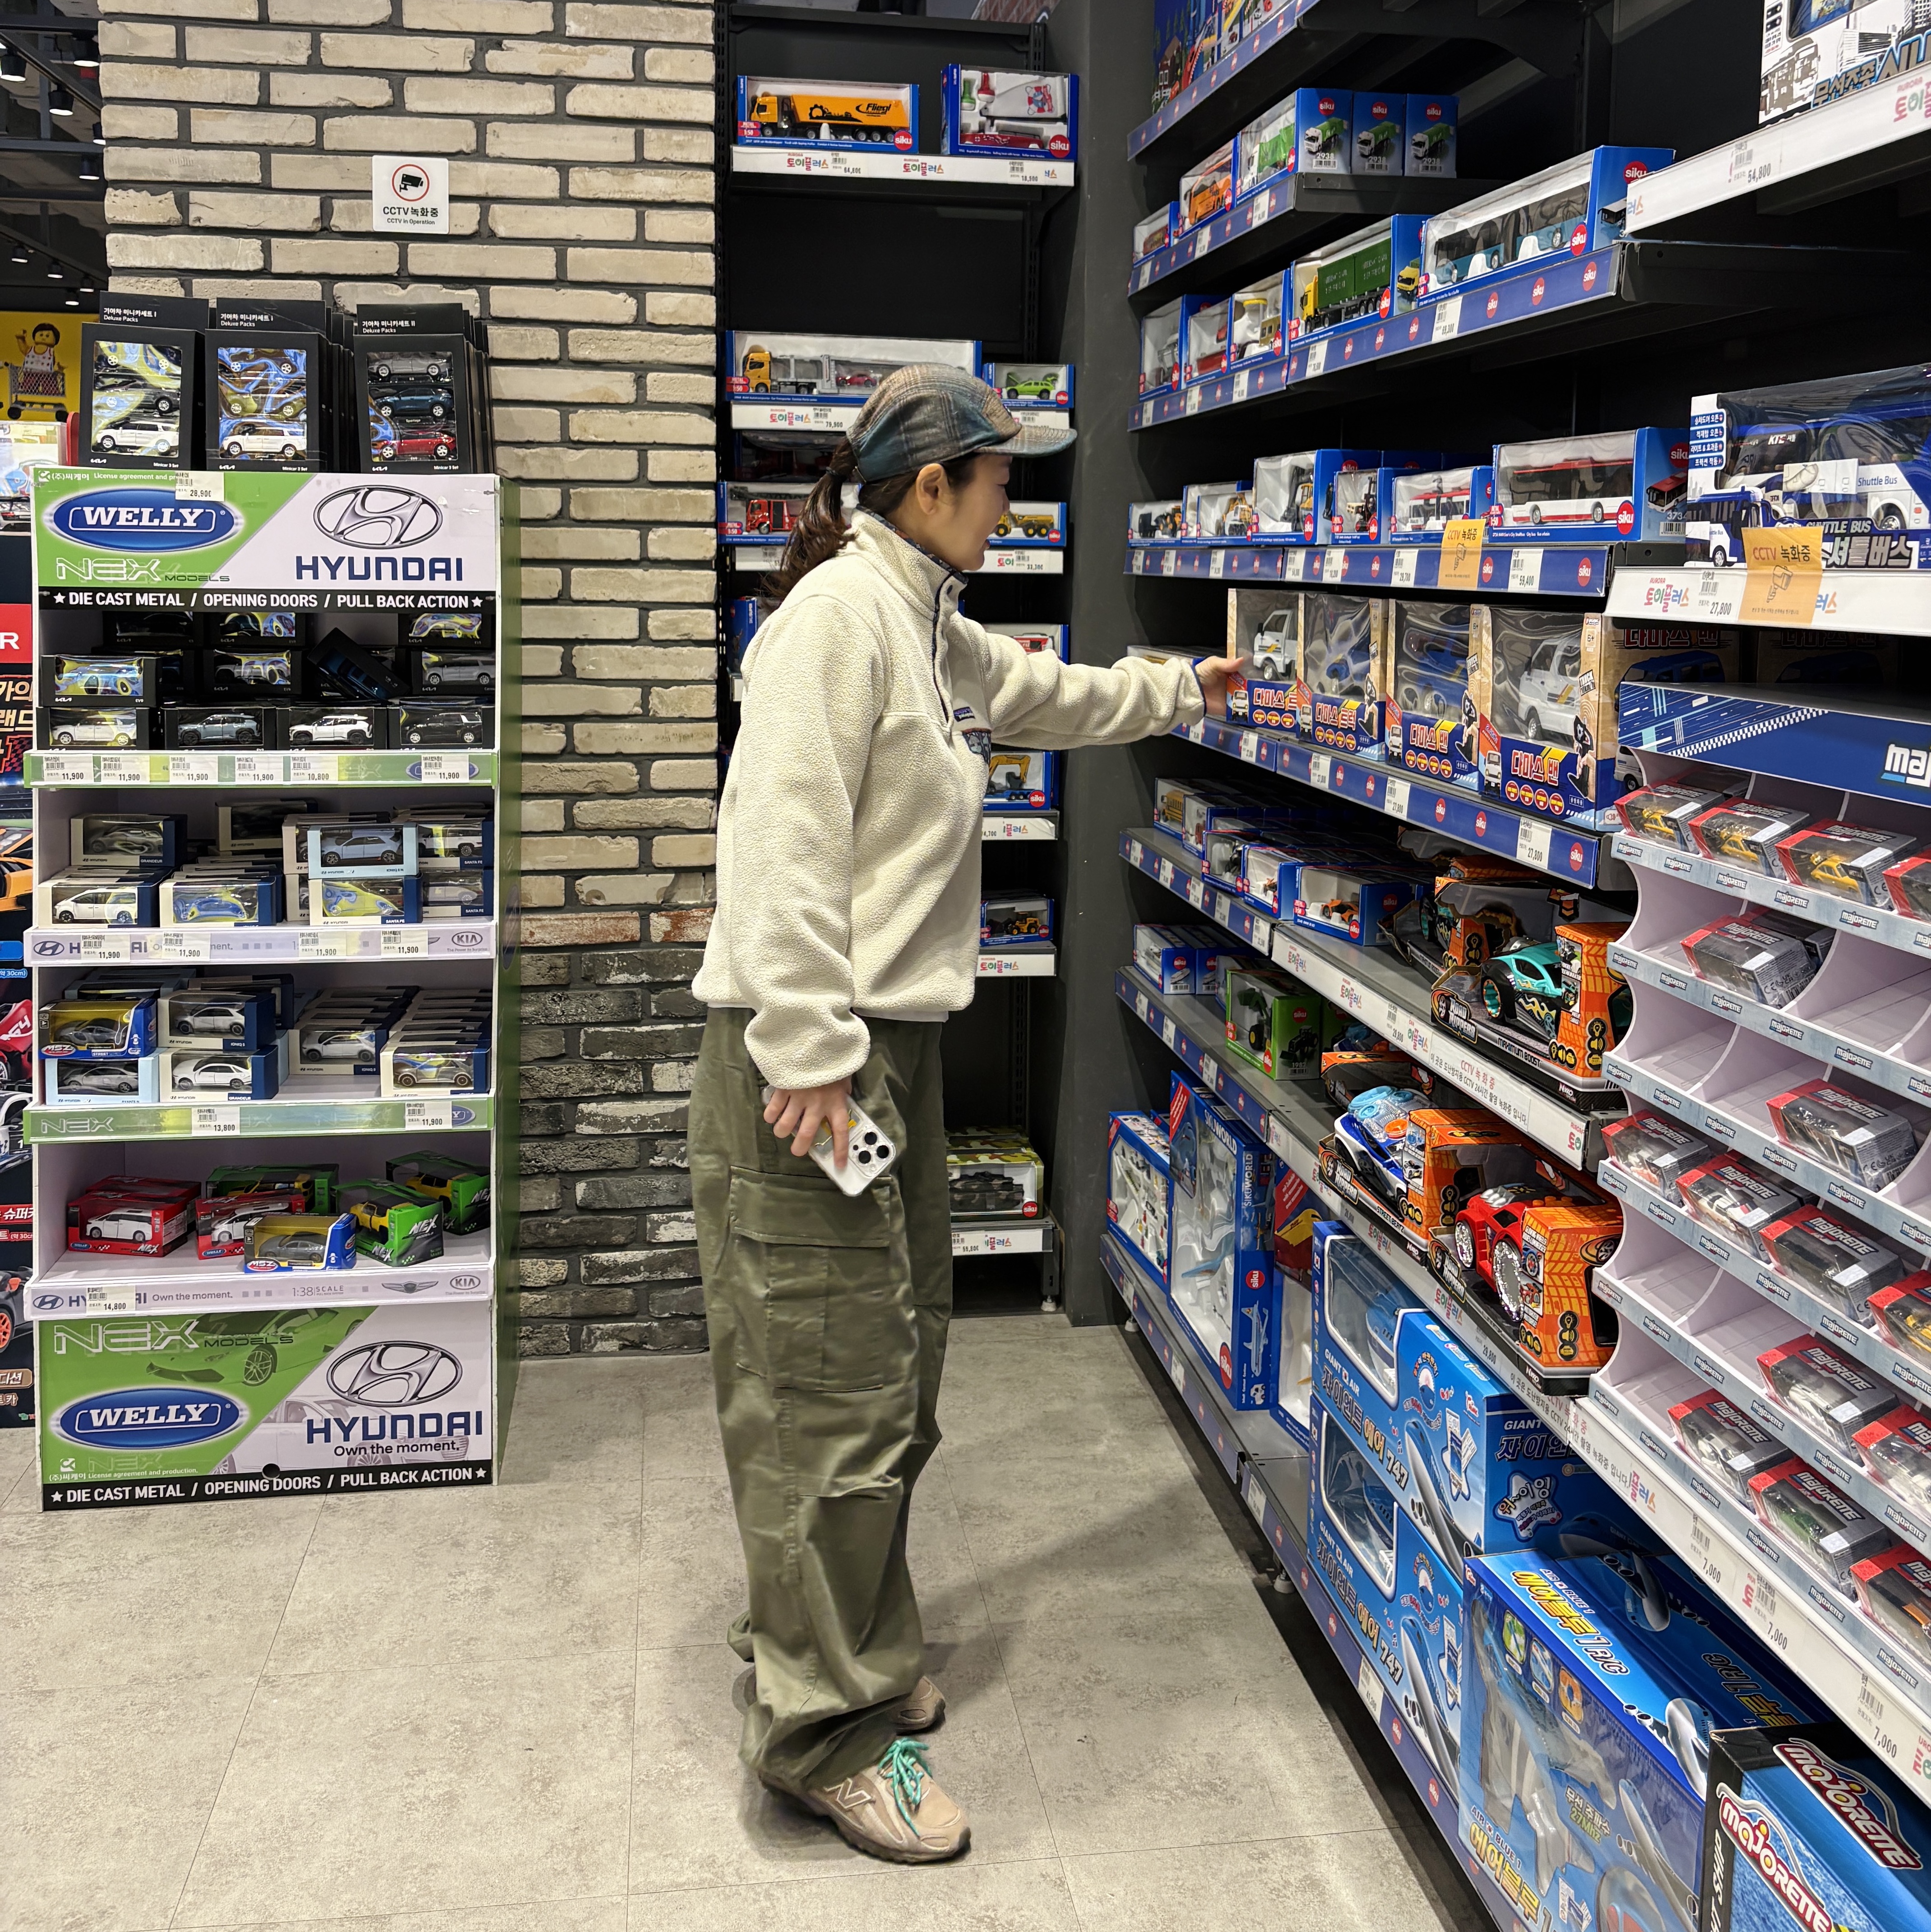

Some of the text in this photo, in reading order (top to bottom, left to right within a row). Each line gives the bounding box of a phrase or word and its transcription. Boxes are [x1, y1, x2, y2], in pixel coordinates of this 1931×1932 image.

[866, 103, 891, 114] Fliegl
[1320, 102, 1334, 111] siku
[1373, 105, 1387, 114] siku
[1426, 108, 1441, 116] siku
[1050, 142, 1069, 151] siku
[787, 157, 829, 171] 토이플러스
[903, 162, 944, 176] 토이플러스
[1748, 163, 1771, 183] 54,800
[383, 207, 409, 216] CCTV
[1571, 232, 1586, 246] siku
[1583, 272, 1596, 284] siku
[1533, 285, 1544, 296] siku
[769, 413, 811, 426] 토이플러스
[94, 473, 117, 481] License
[119, 474, 153, 482] agreement
[1858, 476, 1897, 486] Shuttle Bus
[190, 489, 212, 498] 28,900
[82, 506, 199, 528] WELLY
[1850, 521, 1871, 533] BUS
[1447, 528, 1477, 541] CCTV 녹화중
[1753, 545, 1811, 562] CCTV 녹화중
[1831, 535, 1911, 568] 셔틀버스
[56, 557, 162, 582] NEX
[296, 556, 463, 581] HYUNDAI
[69, 593, 469, 608] DIE CAST METAL OPENING DOORS PULL BACK ACTION
[1644, 585, 1689, 613] 토이플러스
[1710, 602, 1732, 616] 27,800
[1254, 687, 1285, 709] 다마스
[1315, 703, 1357, 731] 다마스 트럭
[1410, 723, 1449, 754] 다마스 밴
[1511, 750, 1559, 787] 다마스 밴
[61, 772, 84, 780] 11,900
[119, 773, 140, 782] 11,900
[187, 773, 208, 781] 11,900
[308, 773, 329, 781] 10,800
[1528, 850, 1542, 862] 27,800
[456, 934, 478, 944] KIA
[98, 950, 120, 959] 11,900
[398, 945, 419, 954] 11,900
[980, 960, 1019, 973] 토이플러스
[1449, 1010, 1476, 1038] RIPPERS
[1498, 1038, 1540, 1067] MAXIMUM BOOST
[1461, 1060, 1474, 1074] CCTV
[1431, 1053, 1435, 1063] 이
[1436, 1056, 1443, 1068] 곳은
[1444, 1062, 1463, 1081] 도난방지용
[1463, 1076, 1474, 1089] CCTV
[1475, 1084, 1488, 1099] 24시간
[1499, 1099, 1512, 1115] 녹화중
[41, 1117, 114, 1134] NEX
[213, 1123, 235, 1132] 13,800
[408, 1215, 438, 1236] NEX
[137, 1244, 159, 1254] NEX
[372, 1244, 394, 1262] NEX
[455, 1278, 476, 1287] KIA
[153, 1293, 174, 1302] Own
[192, 1292, 233, 1300] moment.
[292, 1287, 313, 1297] 1:38
[103, 1302, 126, 1311] 14,800
[54, 1319, 199, 1354] NEX
[204, 1336, 294, 1348] MODELS
[1324, 1348, 1360, 1396] GIANT AIR
[90, 1404, 209, 1427] WELLY
[306, 1411, 482, 1444] HYUNDAI
[1321, 1365, 1408, 1491] 자이언트 에어 747
[334, 1440, 460, 1456] Own the moment.
[113, 1471, 147, 1479] agreement
[162, 1468, 198, 1476] production.
[273, 1468, 472, 1490] DOORS PULL BACK ACTION
[66, 1479, 270, 1502] DIE CAST METAL OPENING
[1702, 1557, 1722, 1584] 7,000
[1540, 1569, 1556, 1584] AIR
[1565, 1589, 1586, 1608] BLUE
[1511, 1569, 1600, 1636] 에어블루
[1583, 1645, 1630, 1675] R/C
[1768, 1623, 1788, 1651] 7,000
[1873, 1725, 1898, 1758] 7,000
[1565, 1785, 1611, 1837] 무선 주파수
[1471, 1805, 1486, 1826] AIR
[1494, 1831, 1517, 1860] BLUE
[1570, 1808, 1602, 1844] 27Mhz
[1715, 1829, 1725, 1905] SHIP
[1468, 1822, 1542, 1927] 에어블루
